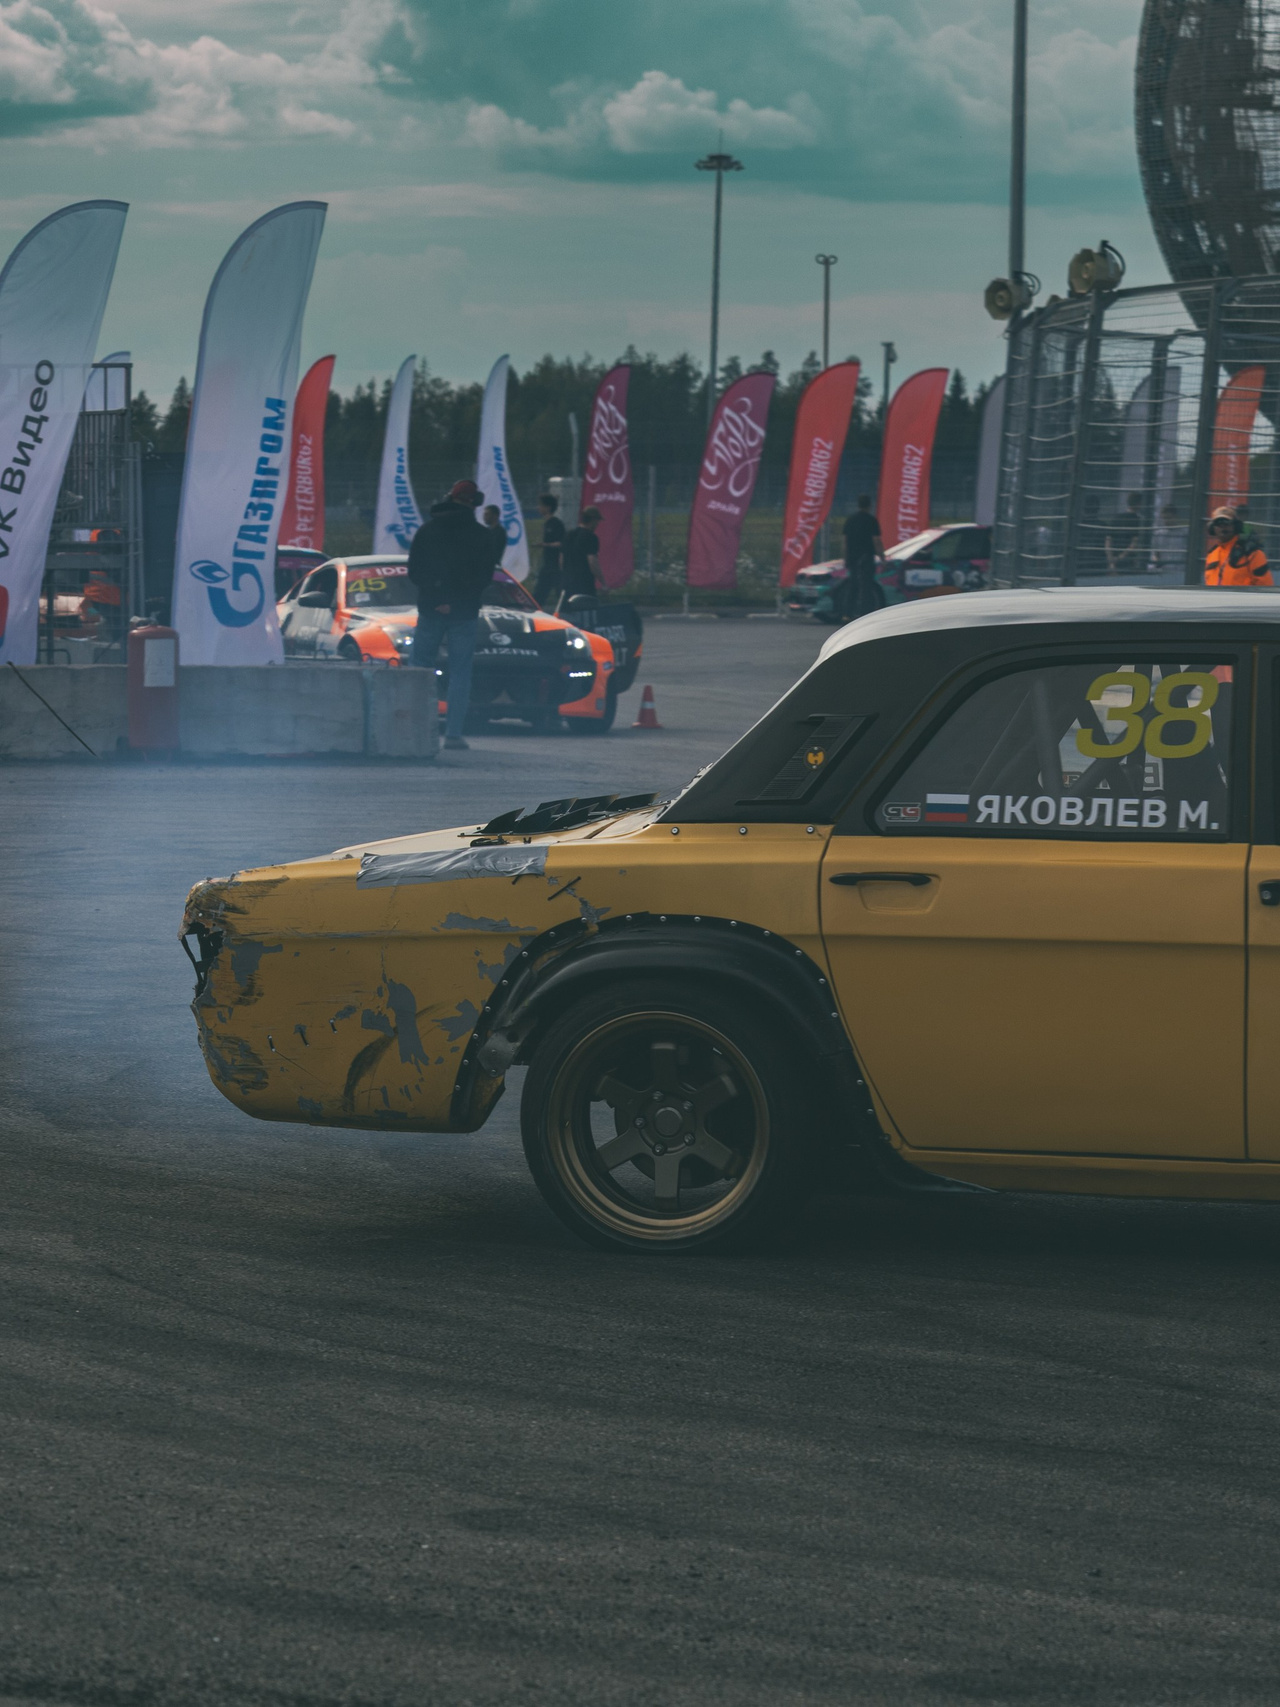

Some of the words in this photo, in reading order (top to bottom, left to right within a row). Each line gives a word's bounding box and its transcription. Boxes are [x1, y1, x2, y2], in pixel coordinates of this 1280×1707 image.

[1, 360, 54, 494] Видео
[233, 397, 287, 560] ГАЗПРОМ
[348, 577, 387, 592] 45
[376, 566, 409, 577] IDD
[1076, 671, 1220, 759] 38
[975, 794, 1168, 828] ЯКОВЛЕВ
[1177, 799, 1220, 830] М.
